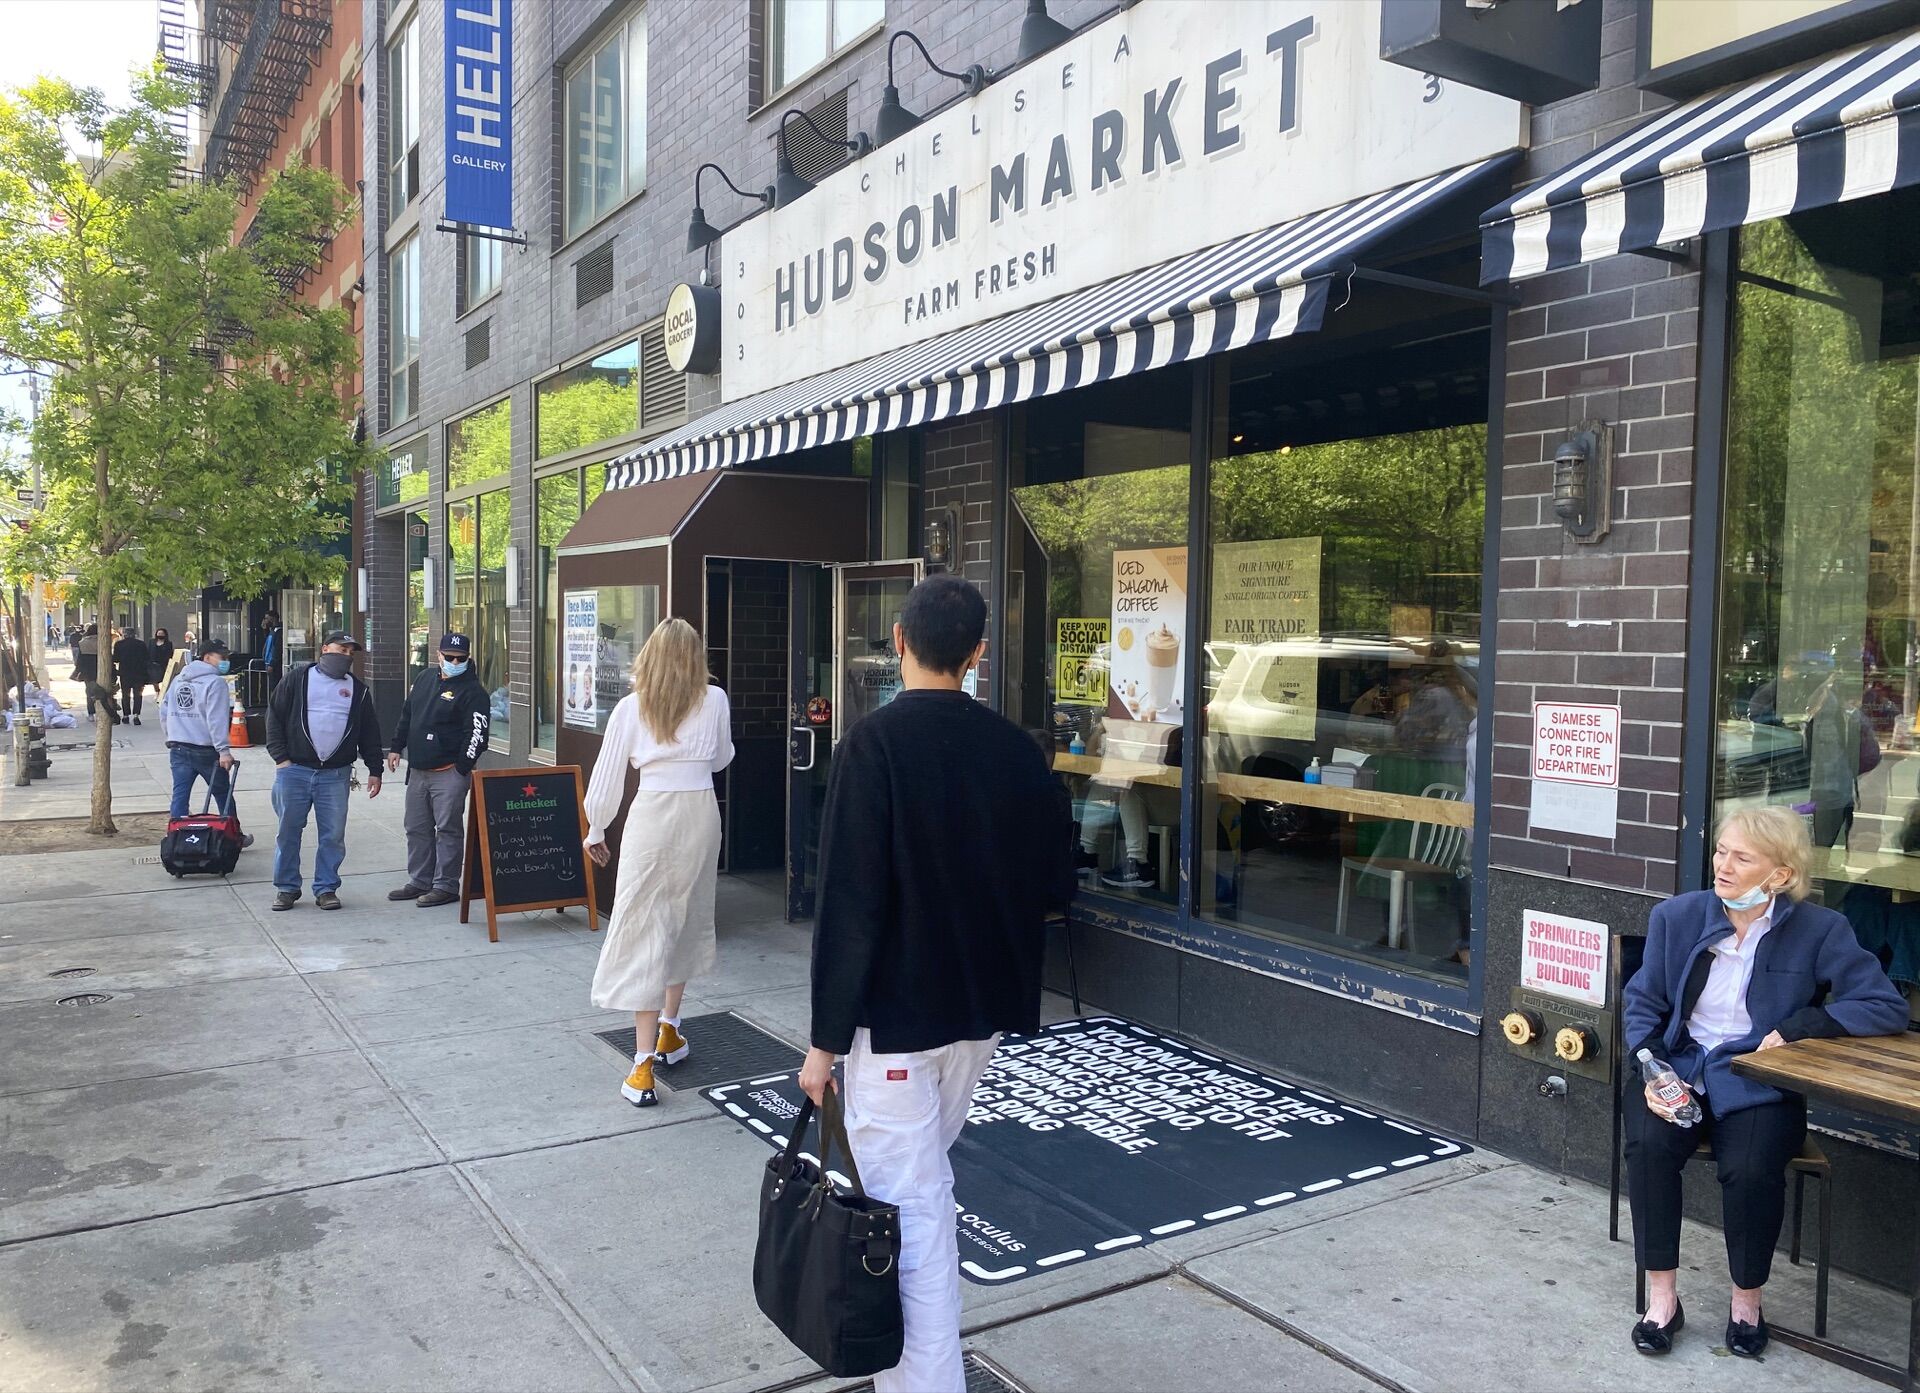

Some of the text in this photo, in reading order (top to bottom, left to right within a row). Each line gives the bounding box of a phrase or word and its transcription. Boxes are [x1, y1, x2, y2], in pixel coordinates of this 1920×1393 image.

[861, 33, 1132, 193] CHELSEA
[452, 154, 506, 172] GALLERY
[775, 16, 1314, 332] HUDSON MARKET
[905, 242, 1056, 325] FARM FRESH
[668, 307, 694, 333] LOCAL
[668, 325, 694, 346] GROCERY
[391, 453, 413, 481] HELLER
[1117, 560, 1145, 576] ICED
[1238, 559, 1294, 573] OUR UNIQUE
[1117, 578, 1169, 594] DALGONA
[1240, 575, 1291, 588] SIGNATURE
[1116, 597, 1159, 612] COFFEE
[1223, 590, 1309, 601] SINGLE ORIGIN COFFEE
[1060, 622, 1107, 631] KEEP YOUR
[1224, 618, 1306, 634] FAIR TRADE
[1060, 631, 1106, 644] SOCIAL
[1075, 664, 1087, 685] 6
[1551, 711, 1601, 727] SIAMESE
[1539, 727, 1613, 744] CONNECTION
[1549, 743, 1601, 760] FOR FIRE
[1537, 758, 1613, 778] DEPARTMENT
[505, 797, 558, 811] Heineken
[488, 812, 557, 829] Start your
[499, 833, 553, 847] Day with
[493, 846, 567, 860] our awesome
[1529, 920, 1602, 951] SPRINKLERS
[1527, 940, 1603, 973] THROUGHOUT
[1536, 961, 1591, 991] BUILDING
[1053, 1032, 1299, 1126] AMOUNT OF SPACE
[1086, 1025, 1345, 1126] YOU ONLY NEED THIS
[997, 1043, 1206, 1131] A DANCE STUDIO,
[1027, 1036, 1293, 1142] IN YOUR HOME TO FIT
[986, 1099, 1065, 1132] RING
[1076, 1094, 1158, 1133] WALL,
[1063, 1110, 1160, 1156] TABLE,
[959, 1228, 1005, 1257] FACEBOOK
